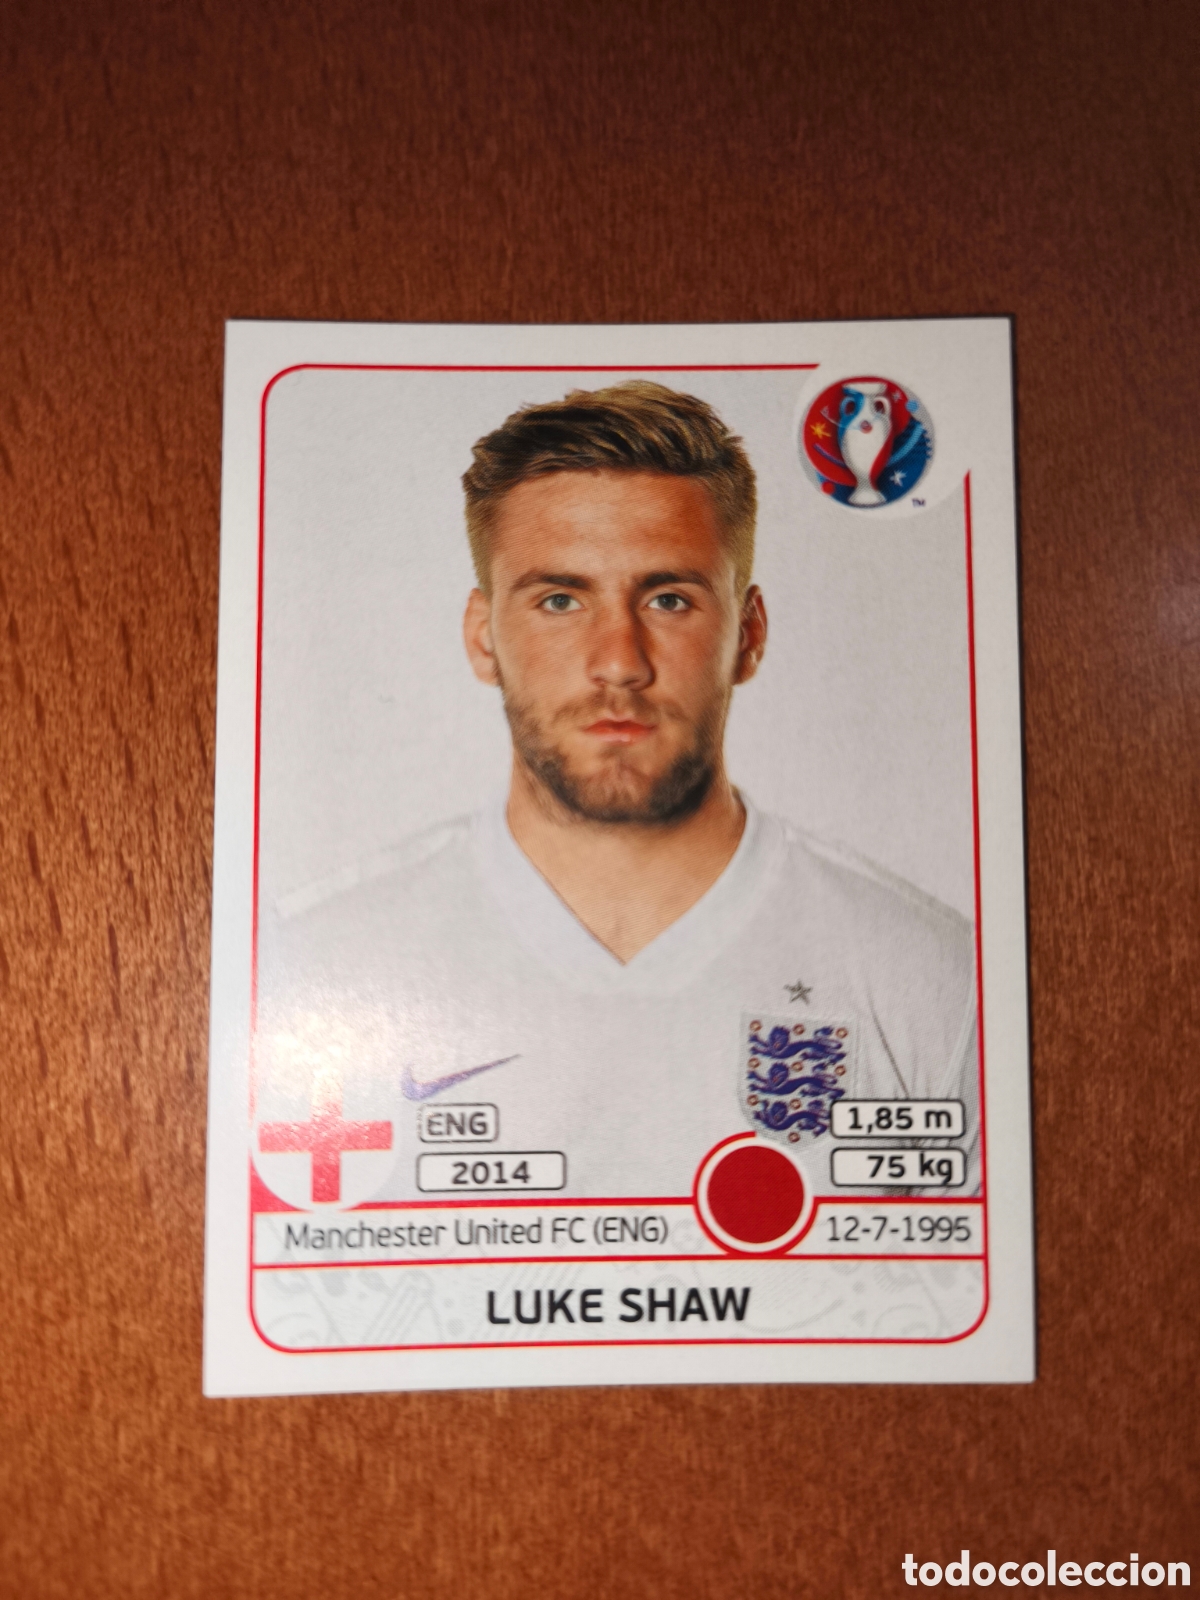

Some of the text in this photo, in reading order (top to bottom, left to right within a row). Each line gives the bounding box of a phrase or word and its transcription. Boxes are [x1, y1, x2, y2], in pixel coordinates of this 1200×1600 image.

[427, 1112, 488, 1138] ENG
[847, 1107, 953, 1134] 1,85 m
[452, 1161, 532, 1185] 2014
[867, 1153, 954, 1184] 75 kg
[284, 1215, 669, 1250] Manchester United FC (ENG)
[827, 1216, 972, 1243] 12-7-1995
[487, 1286, 751, 1325] LUKE SHAW
